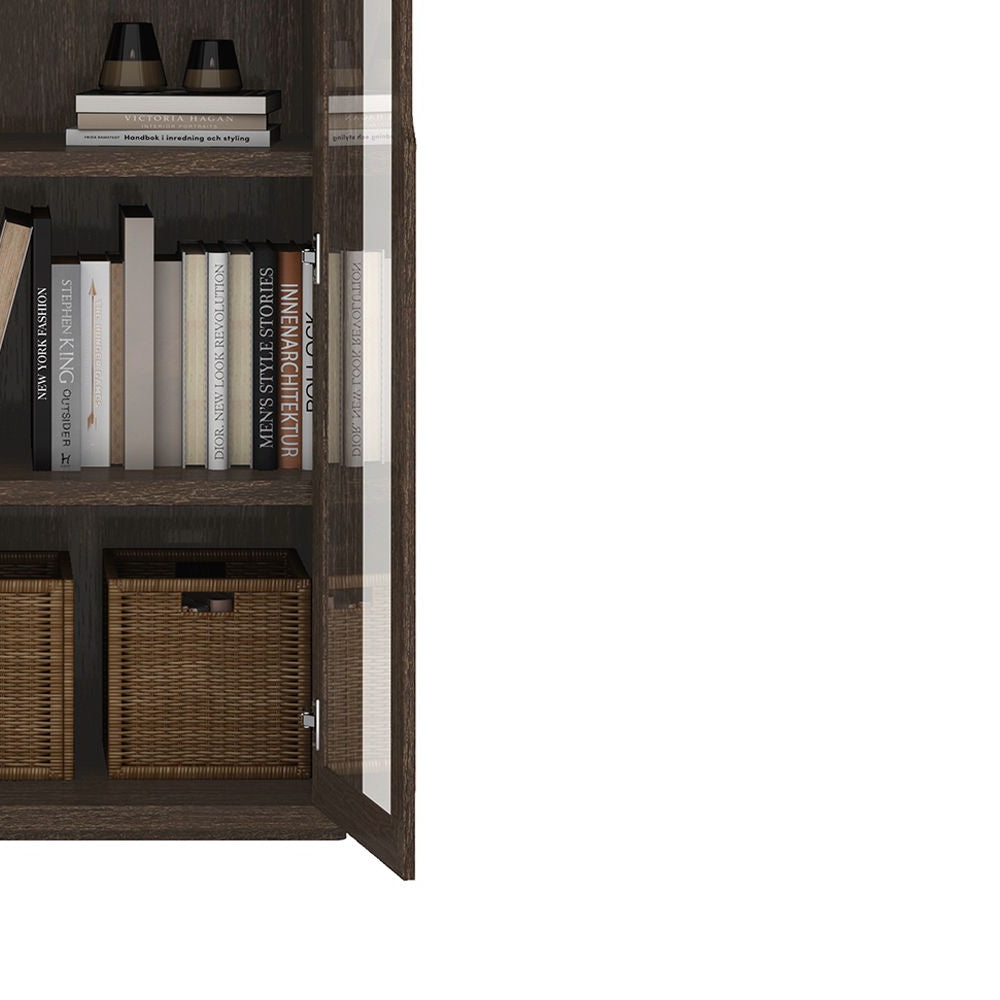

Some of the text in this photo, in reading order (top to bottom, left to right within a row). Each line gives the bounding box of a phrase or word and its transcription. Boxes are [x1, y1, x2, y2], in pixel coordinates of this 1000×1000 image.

[124, 134, 159, 142] Handbok
[166, 134, 204, 143] inredning
[206, 134, 221, 142] och
[223, 134, 250, 143] styling
[37, 287, 47, 400] NEW YORK FASHION
[58, 279, 75, 384] STEPHEN KING
[214, 264, 225, 348] REVOLUTION
[214, 352, 225, 387] LOOK
[259, 267, 274, 449] MEN'S STYLE STORIES
[280, 283, 298, 457] INNENARCHITEKTUR
[61, 388, 72, 447] OUTSIDER
[214, 389, 225, 422] NEW
